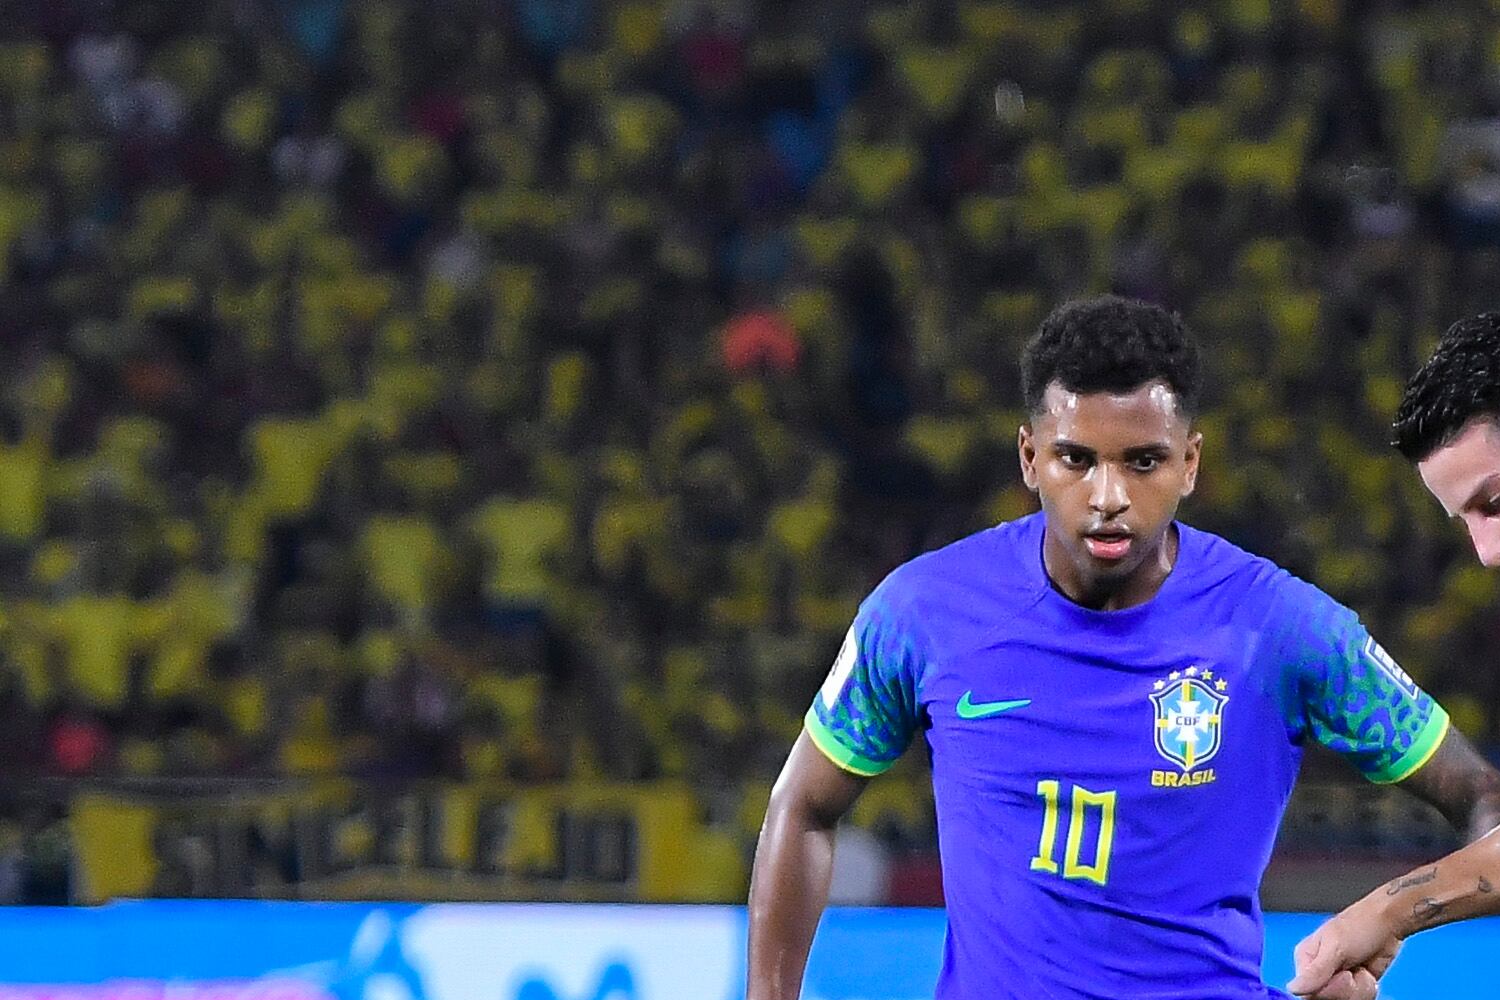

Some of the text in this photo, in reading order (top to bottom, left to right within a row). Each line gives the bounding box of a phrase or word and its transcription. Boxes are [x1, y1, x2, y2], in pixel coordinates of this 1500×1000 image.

[1175, 716, 1201, 727] CBF
[1151, 768, 1217, 788] BRASIL
[1030, 780, 1117, 886] 10
